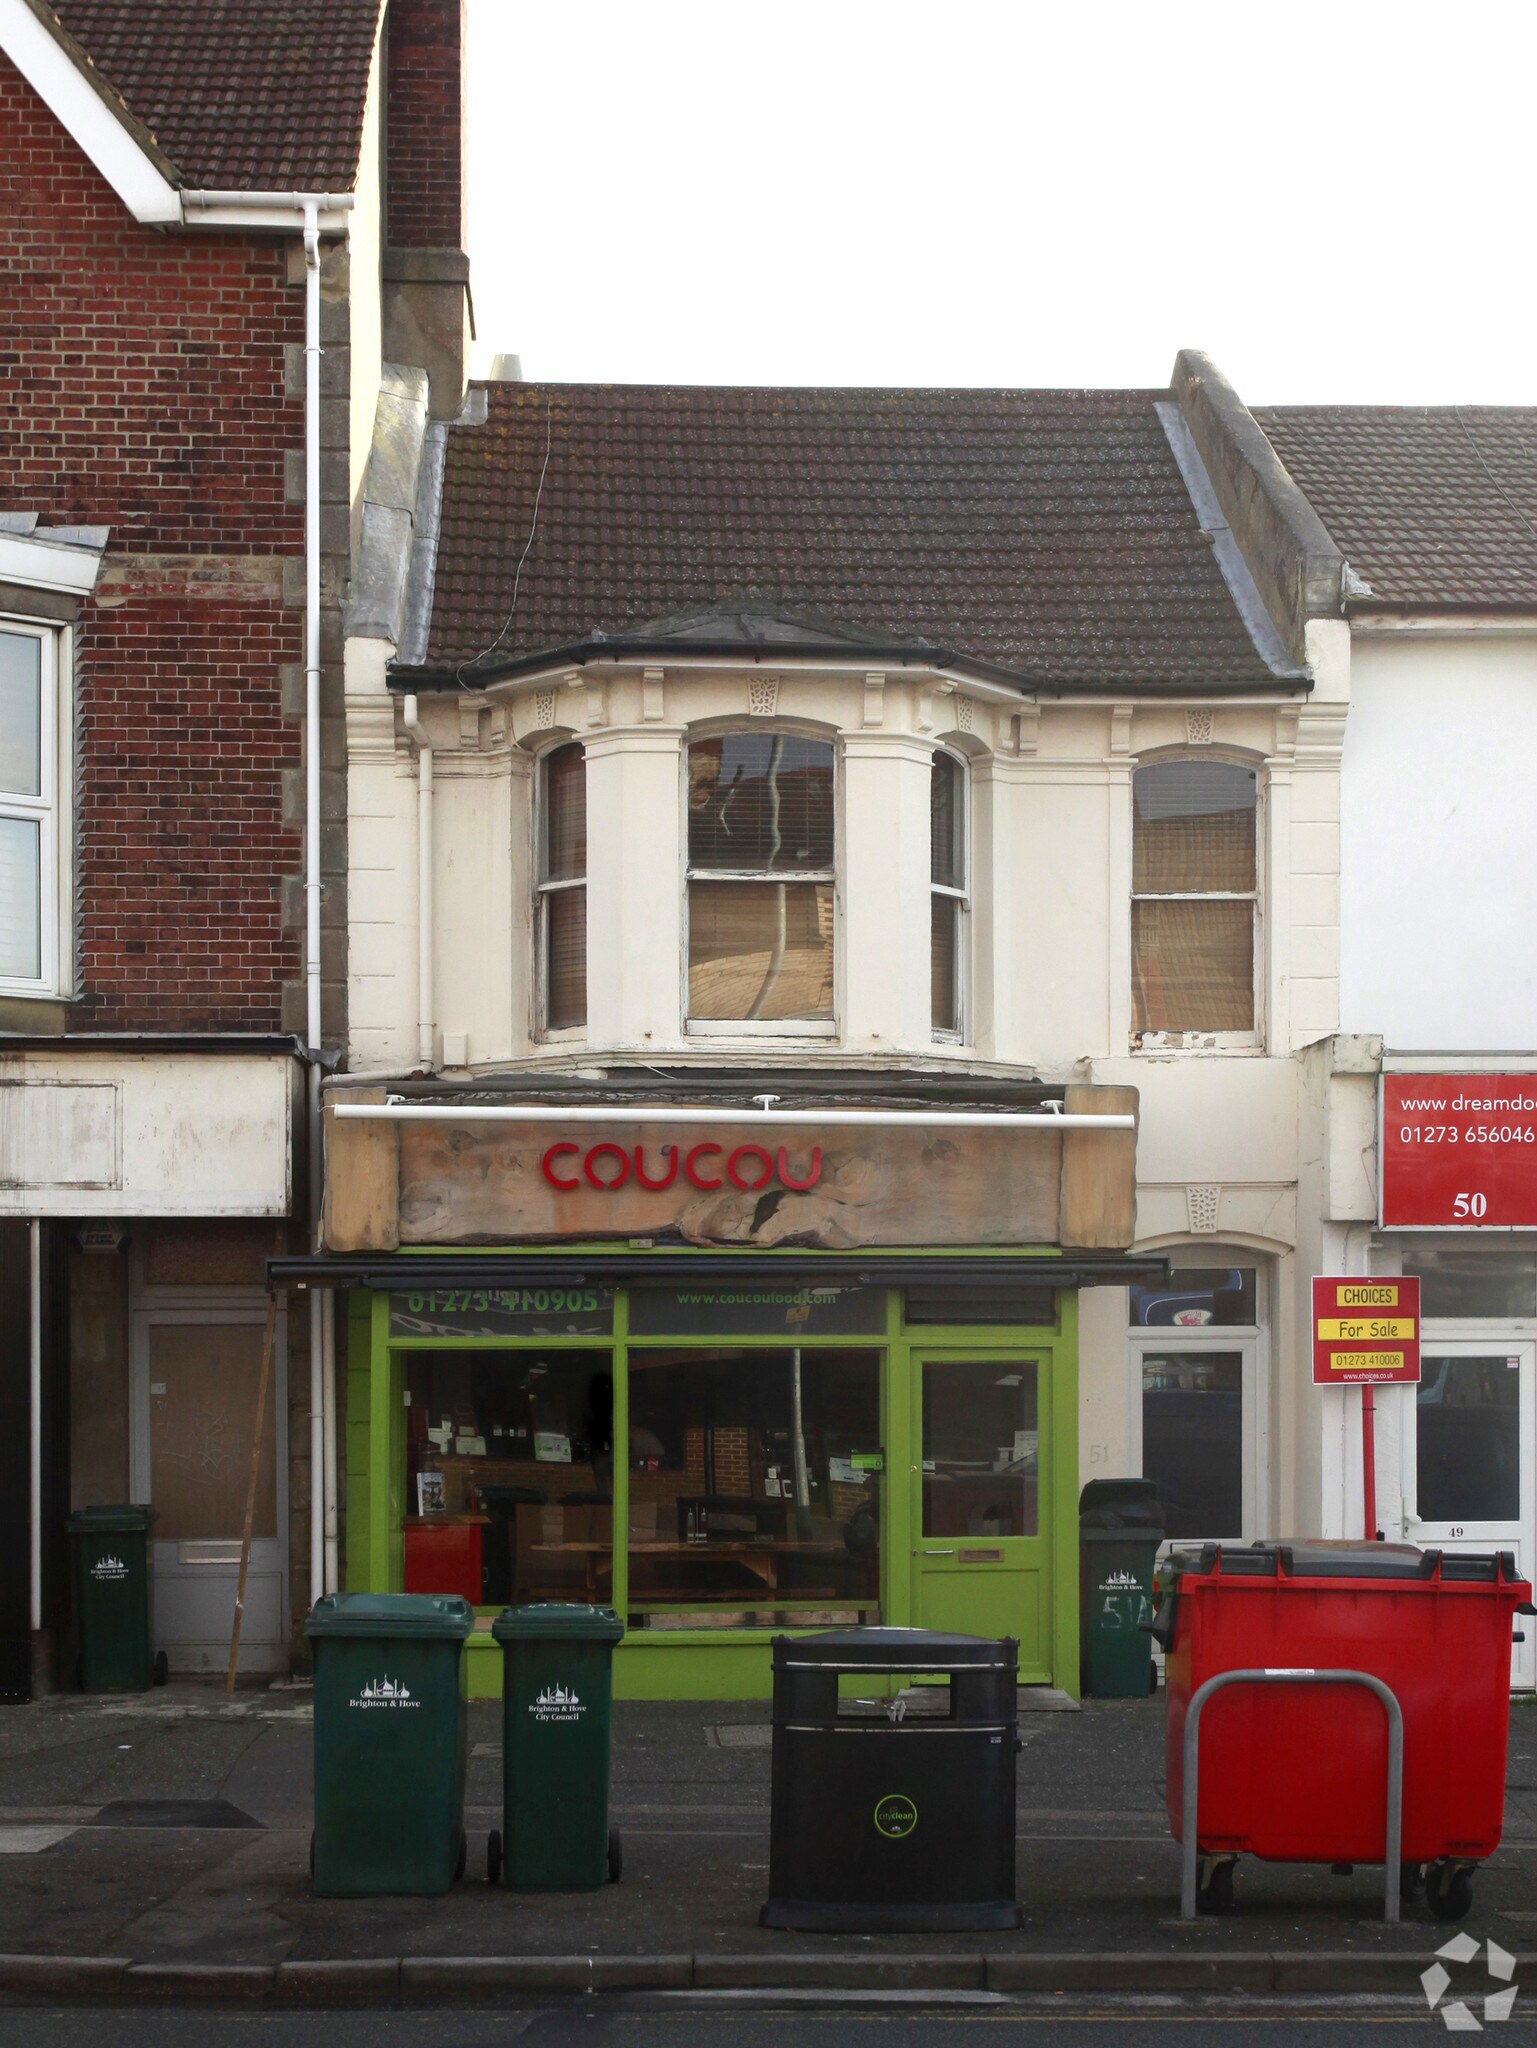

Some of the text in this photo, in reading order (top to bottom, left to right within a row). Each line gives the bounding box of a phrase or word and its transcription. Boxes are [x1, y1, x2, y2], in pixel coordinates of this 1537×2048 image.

[1451, 1094, 1537, 1110] dreamdo
[1400, 1126, 1535, 1143] 01273 656046
[542, 1142, 822, 1190] COUCOU
[1453, 1192, 1487, 1218] 50
[408, 1290, 489, 1312] 01273
[500, 1288, 599, 1312] 410905
[678, 1291, 836, 1304] www.coucoufood.com
[1344, 1289, 1392, 1303] CHOICES
[1340, 1321, 1398, 1337] For Sale
[1336, 1354, 1400, 1366] 01273 410006
[1448, 1527, 1463, 1537] 49
[349, 1699, 421, 1708] Brighton & Hove
[528, 1705, 559, 1713] Brighton
[535, 1713, 579, 1721] City Council
[879, 1812, 913, 1821] cityclean
